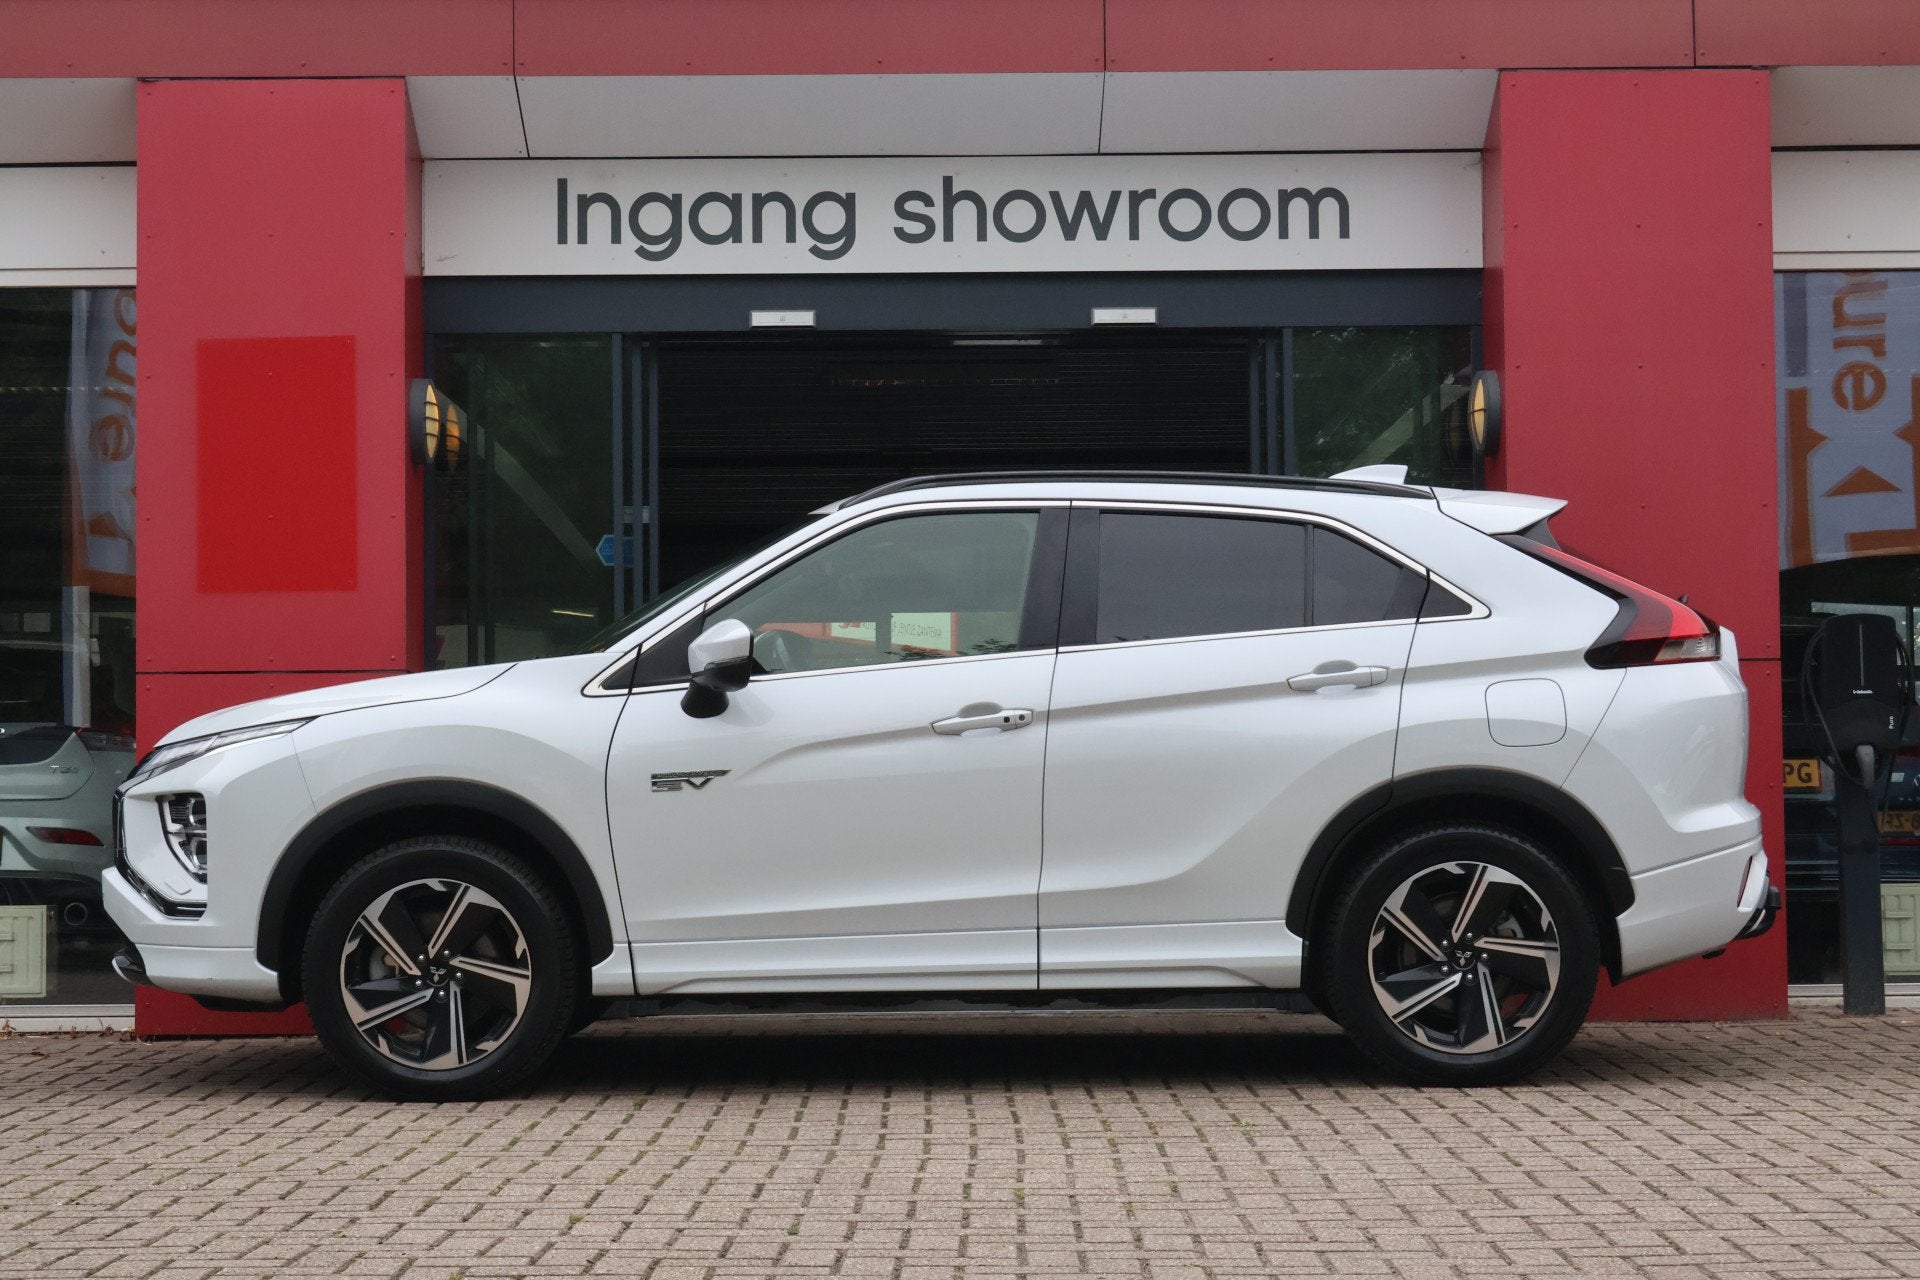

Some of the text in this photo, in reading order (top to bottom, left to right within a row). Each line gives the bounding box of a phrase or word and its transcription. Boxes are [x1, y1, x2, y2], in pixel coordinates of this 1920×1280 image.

[557, 176, 1349, 261] Ingang showroom
[1832, 272, 1887, 411] ure
